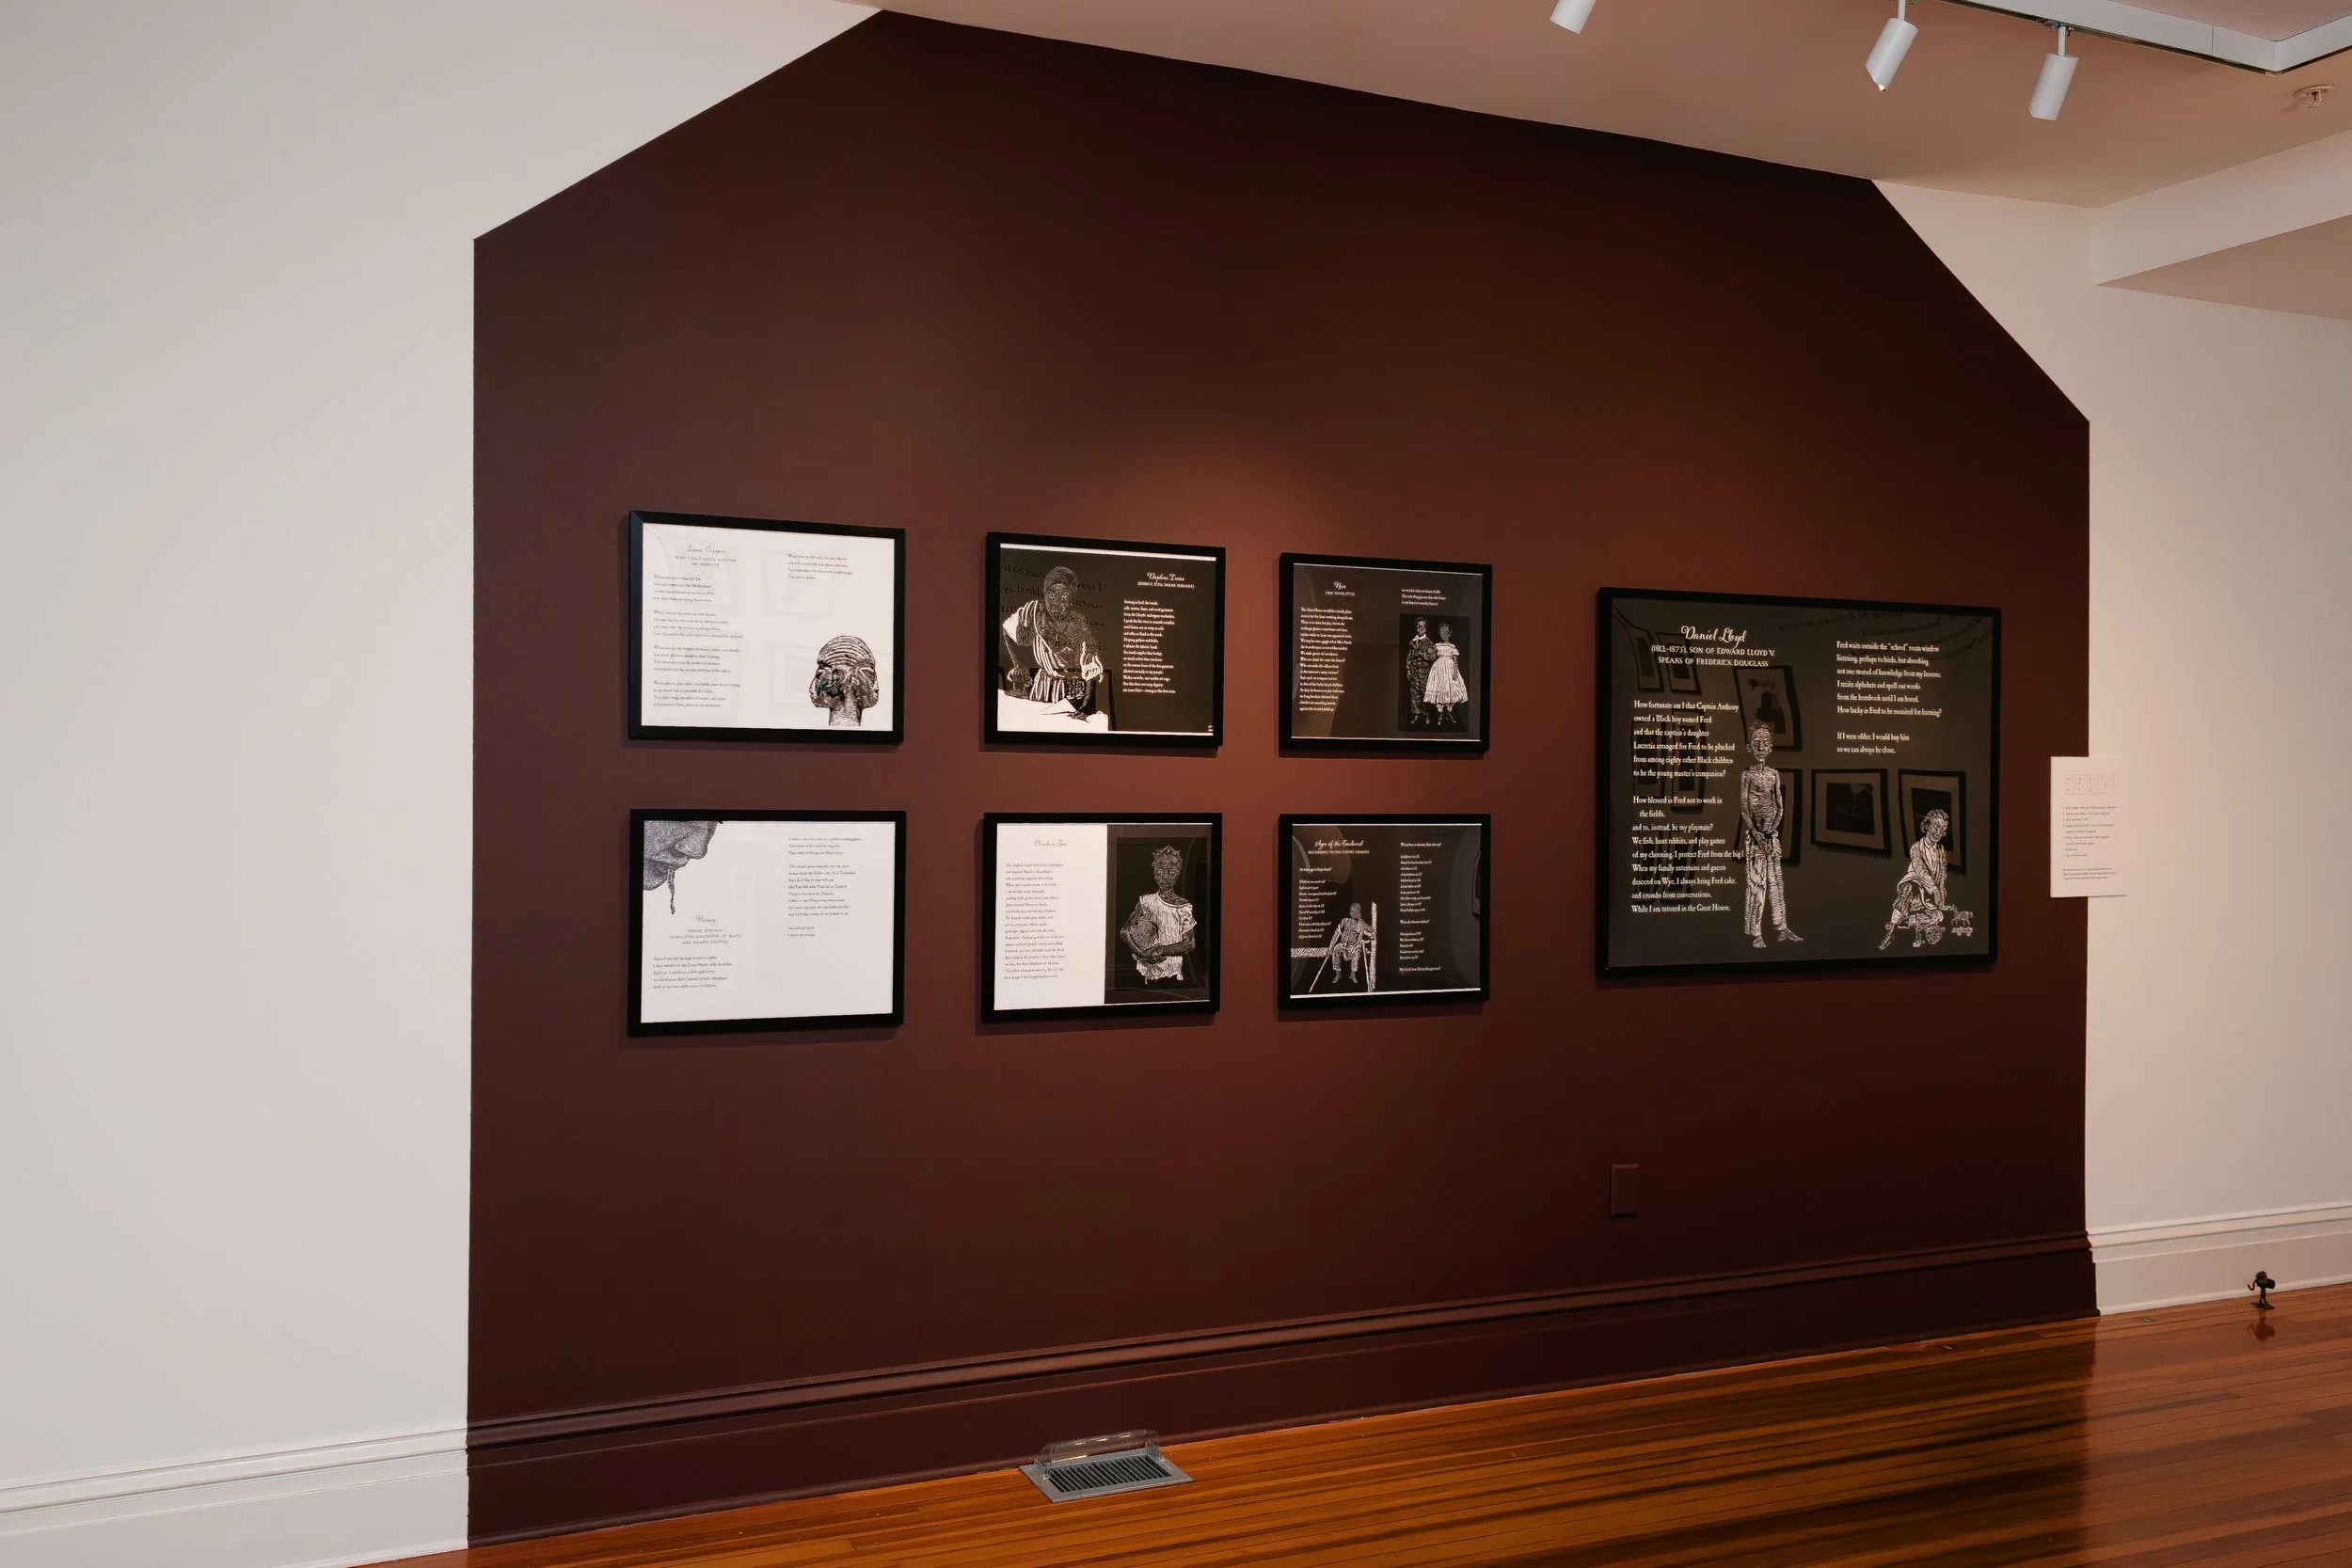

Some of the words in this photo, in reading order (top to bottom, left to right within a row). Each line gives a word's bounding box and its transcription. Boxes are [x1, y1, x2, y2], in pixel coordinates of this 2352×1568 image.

[1680, 626, 1718, 641] Daniel
[1718, 627, 1747, 648] Lloyd
[1717, 647, 1744, 656] EDWARD
[1696, 657, 1732, 666] FREDERICK
[1696, 702, 1716, 711] Captain
[1717, 704, 1739, 712] Anthony
[1672, 716, 1681, 724] boy
[1664, 729, 1686, 737] captain's
[1687, 729, 1709, 738] daughter
[1657, 742, 1678, 752] arranged
[1714, 743, 1735, 752] plucked
[1666, 756, 1681, 765] eighty
[1695, 770, 1726, 779] companion?
[1688, 824, 1713, 832] playmate?
[1698, 837, 1708, 846] play
[1732, 850, 1741, 859] big
[1659, 864, 1675, 873] family
[1680, 878, 1696, 886] always
[1697, 878, 1710, 886] bring
